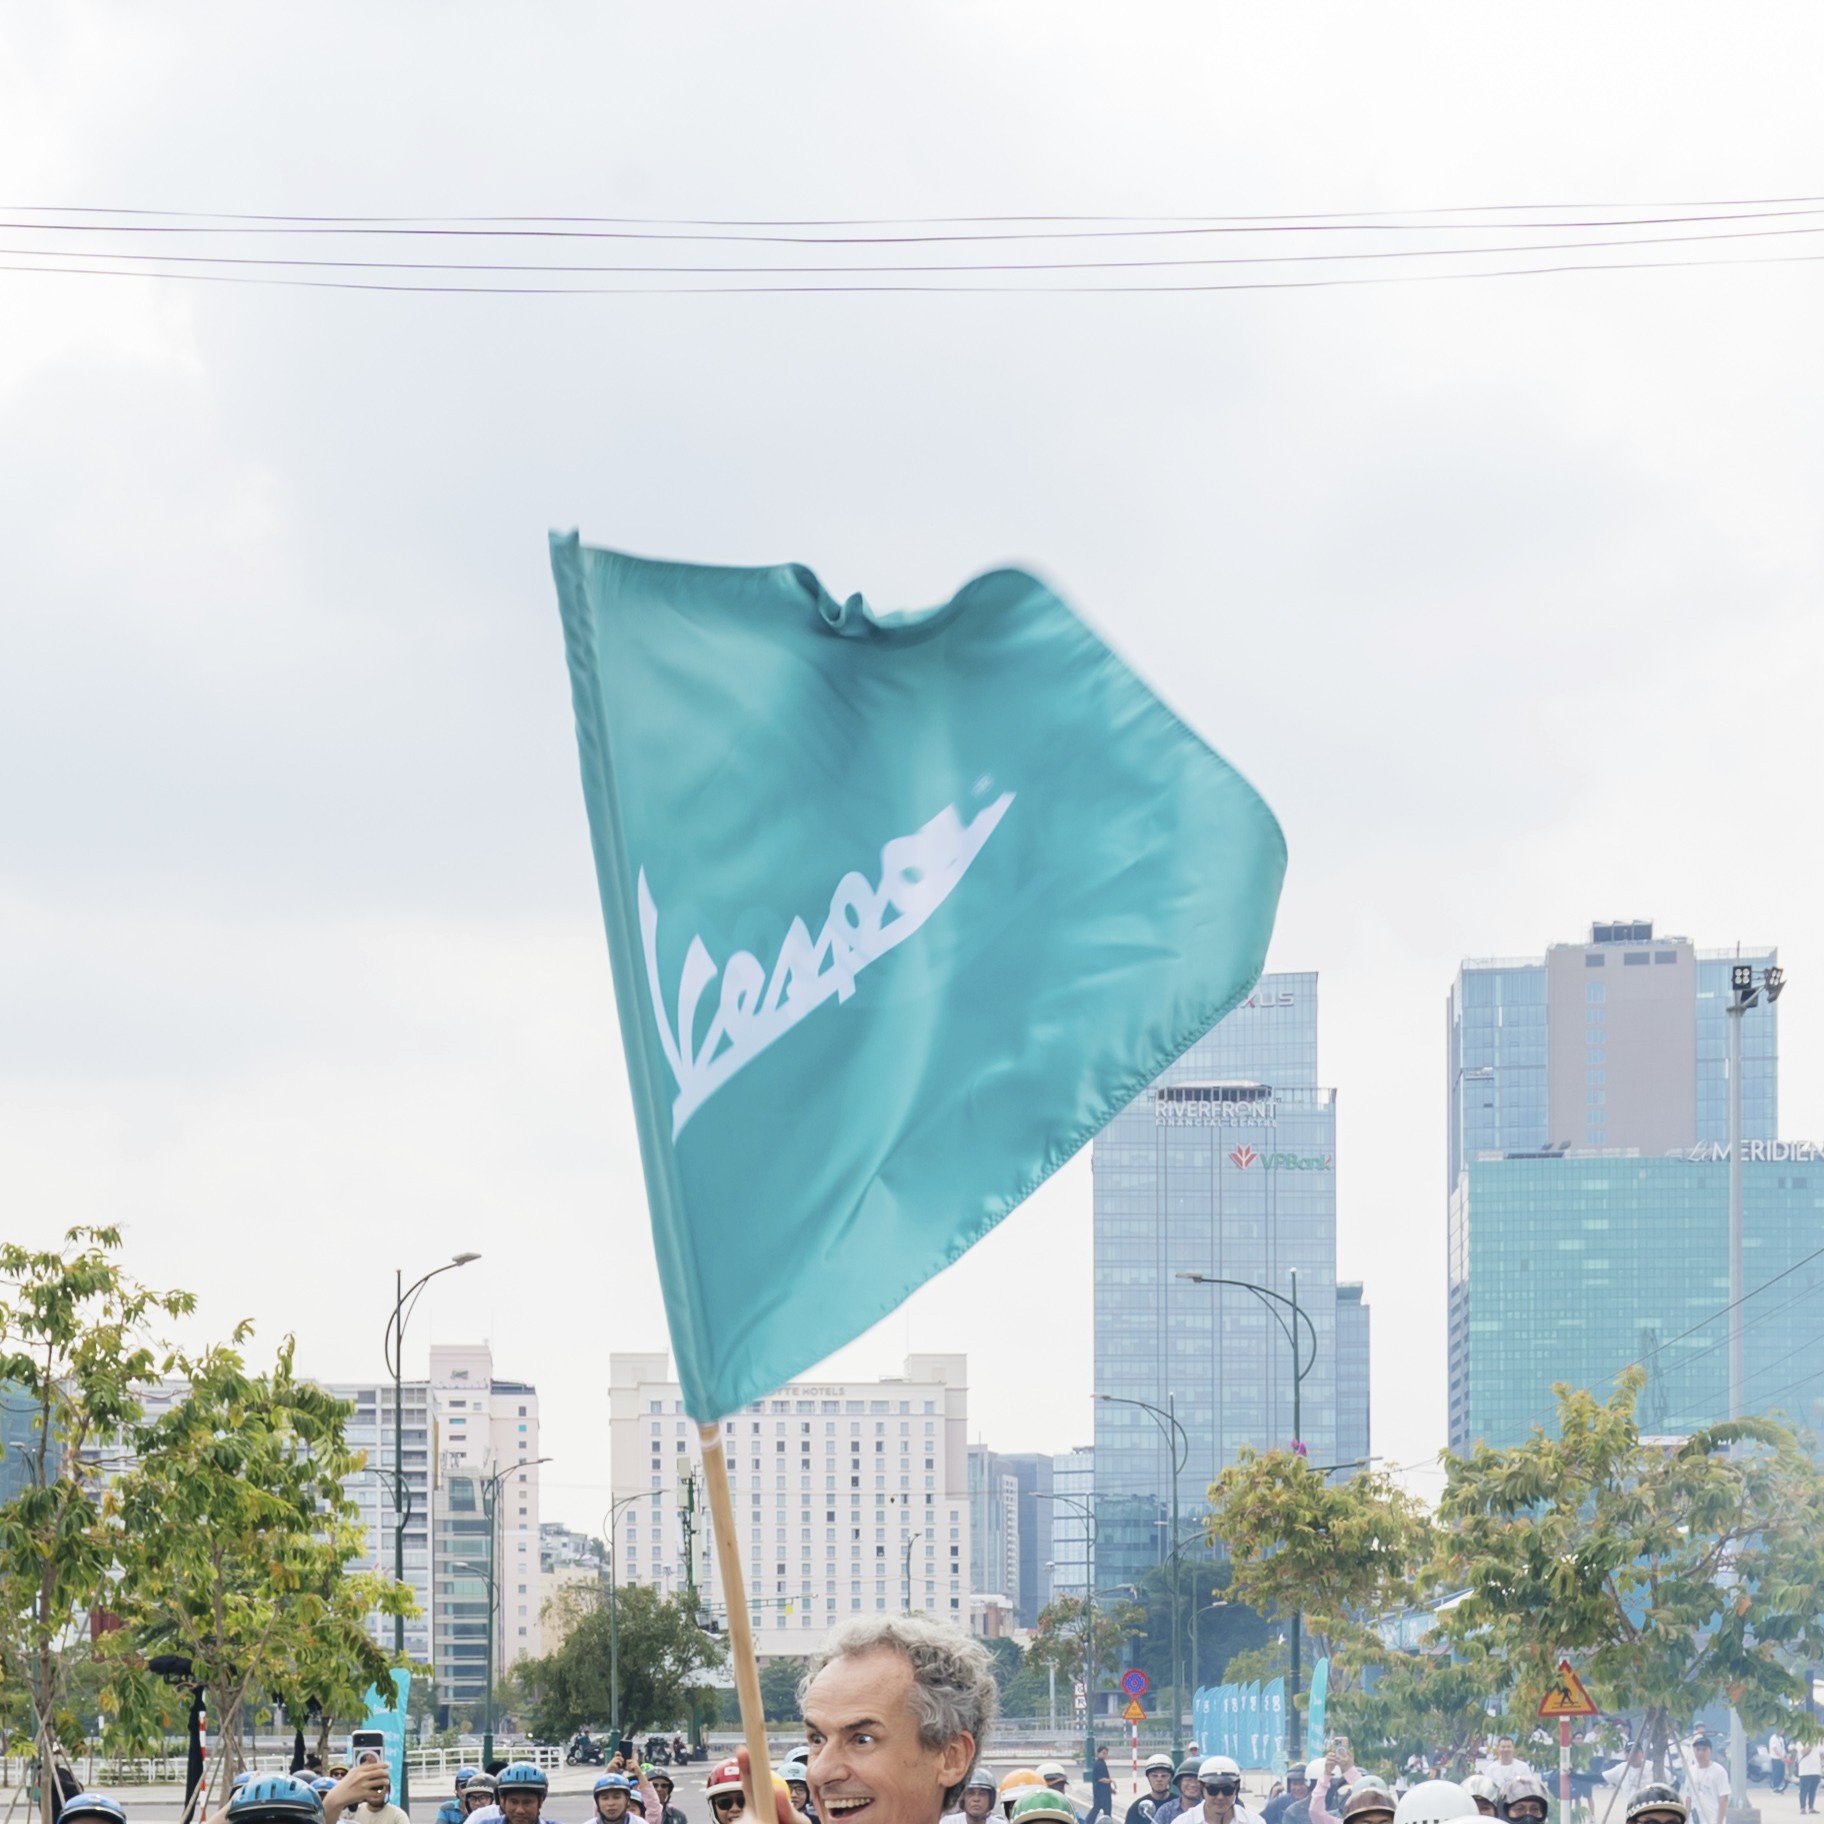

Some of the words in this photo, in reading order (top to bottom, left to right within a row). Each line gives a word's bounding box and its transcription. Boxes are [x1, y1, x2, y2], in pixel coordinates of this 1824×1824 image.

[637, 780, 1017, 1145] Vespa
[1155, 1100, 1277, 1118] RIVERFRONT
[1155, 1119, 1223, 1127] FINANCIAL
[1261, 1153, 1332, 1170] VPBank
[803, 1387, 845, 1396] HOTELS
